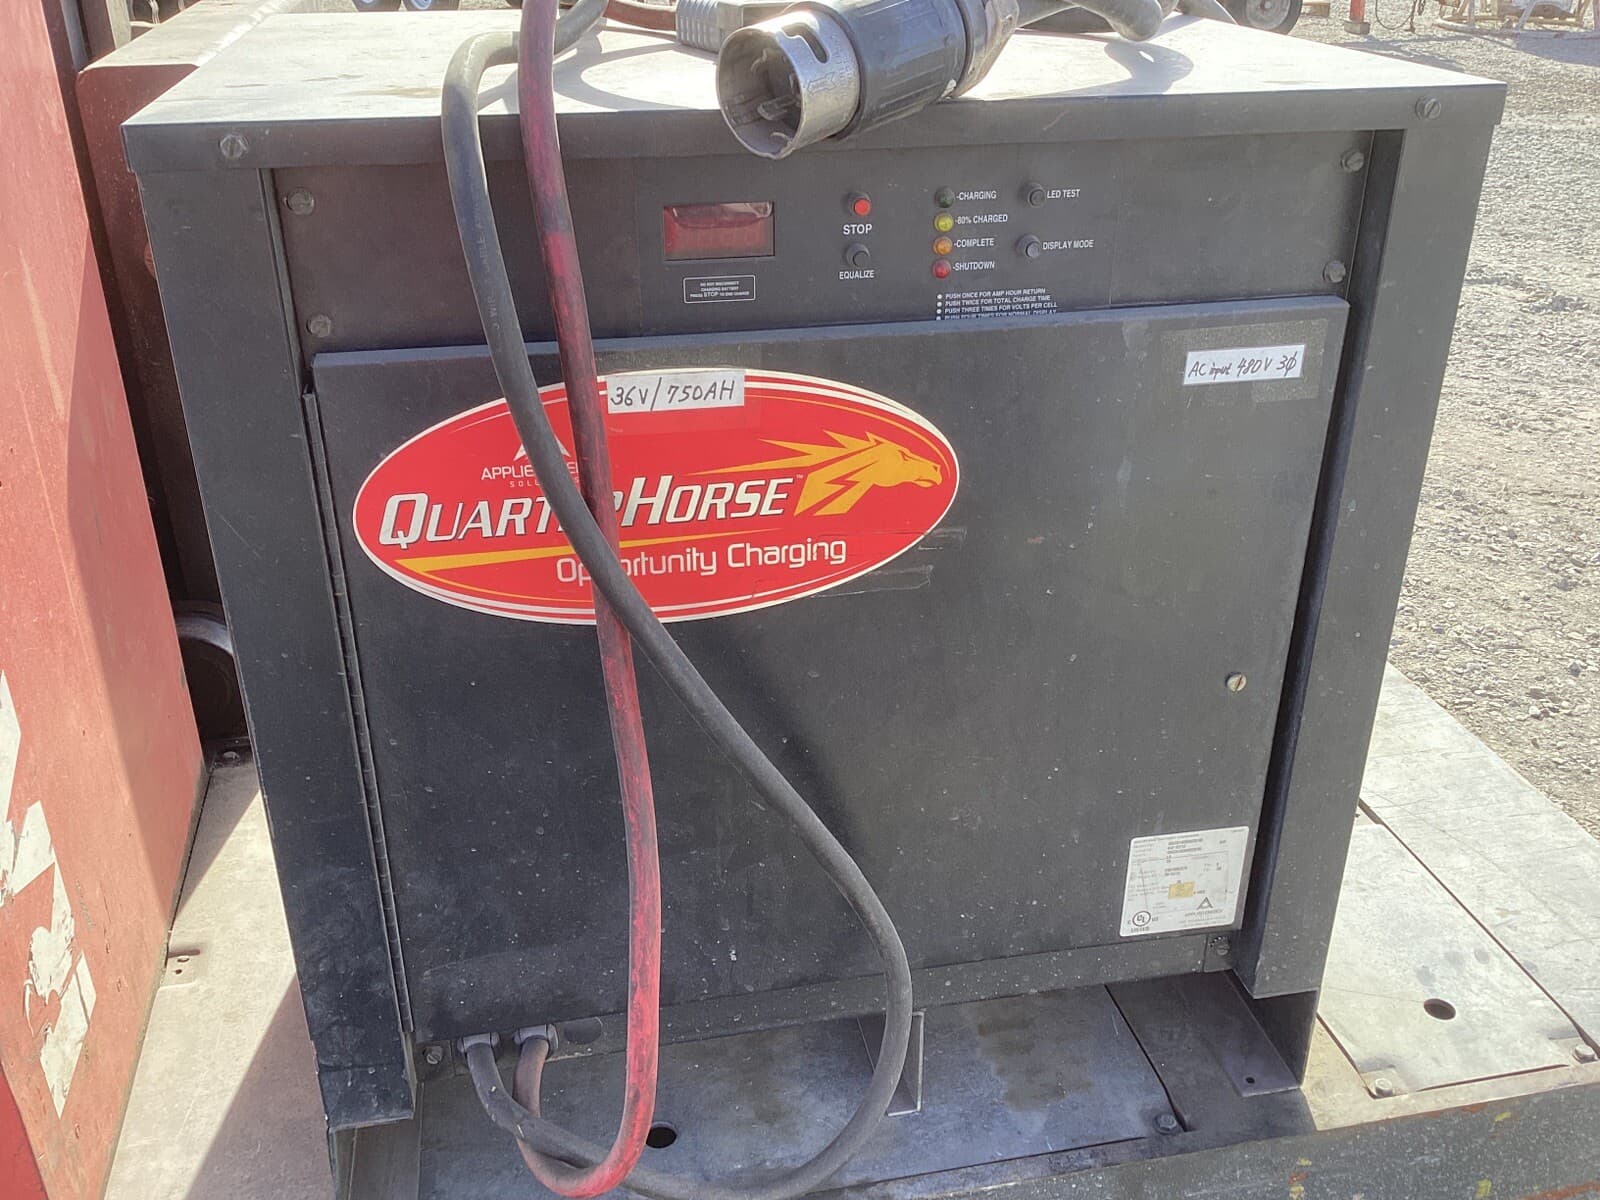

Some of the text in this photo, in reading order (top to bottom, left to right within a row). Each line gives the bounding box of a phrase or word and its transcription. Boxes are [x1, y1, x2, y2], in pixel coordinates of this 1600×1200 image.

[1046, 189, 1080, 199] LED TEST
[973, 214, 1008, 224] CHARGED
[842, 223, 872, 235] STOP
[1042, 240, 1094, 250] DISPLAY MODE
[839, 270, 875, 280] EQUALIZE
[1187, 361, 1206, 377] AC
[481, 464, 537, 480] APPLIE
[727, 538, 846, 569] Charging
